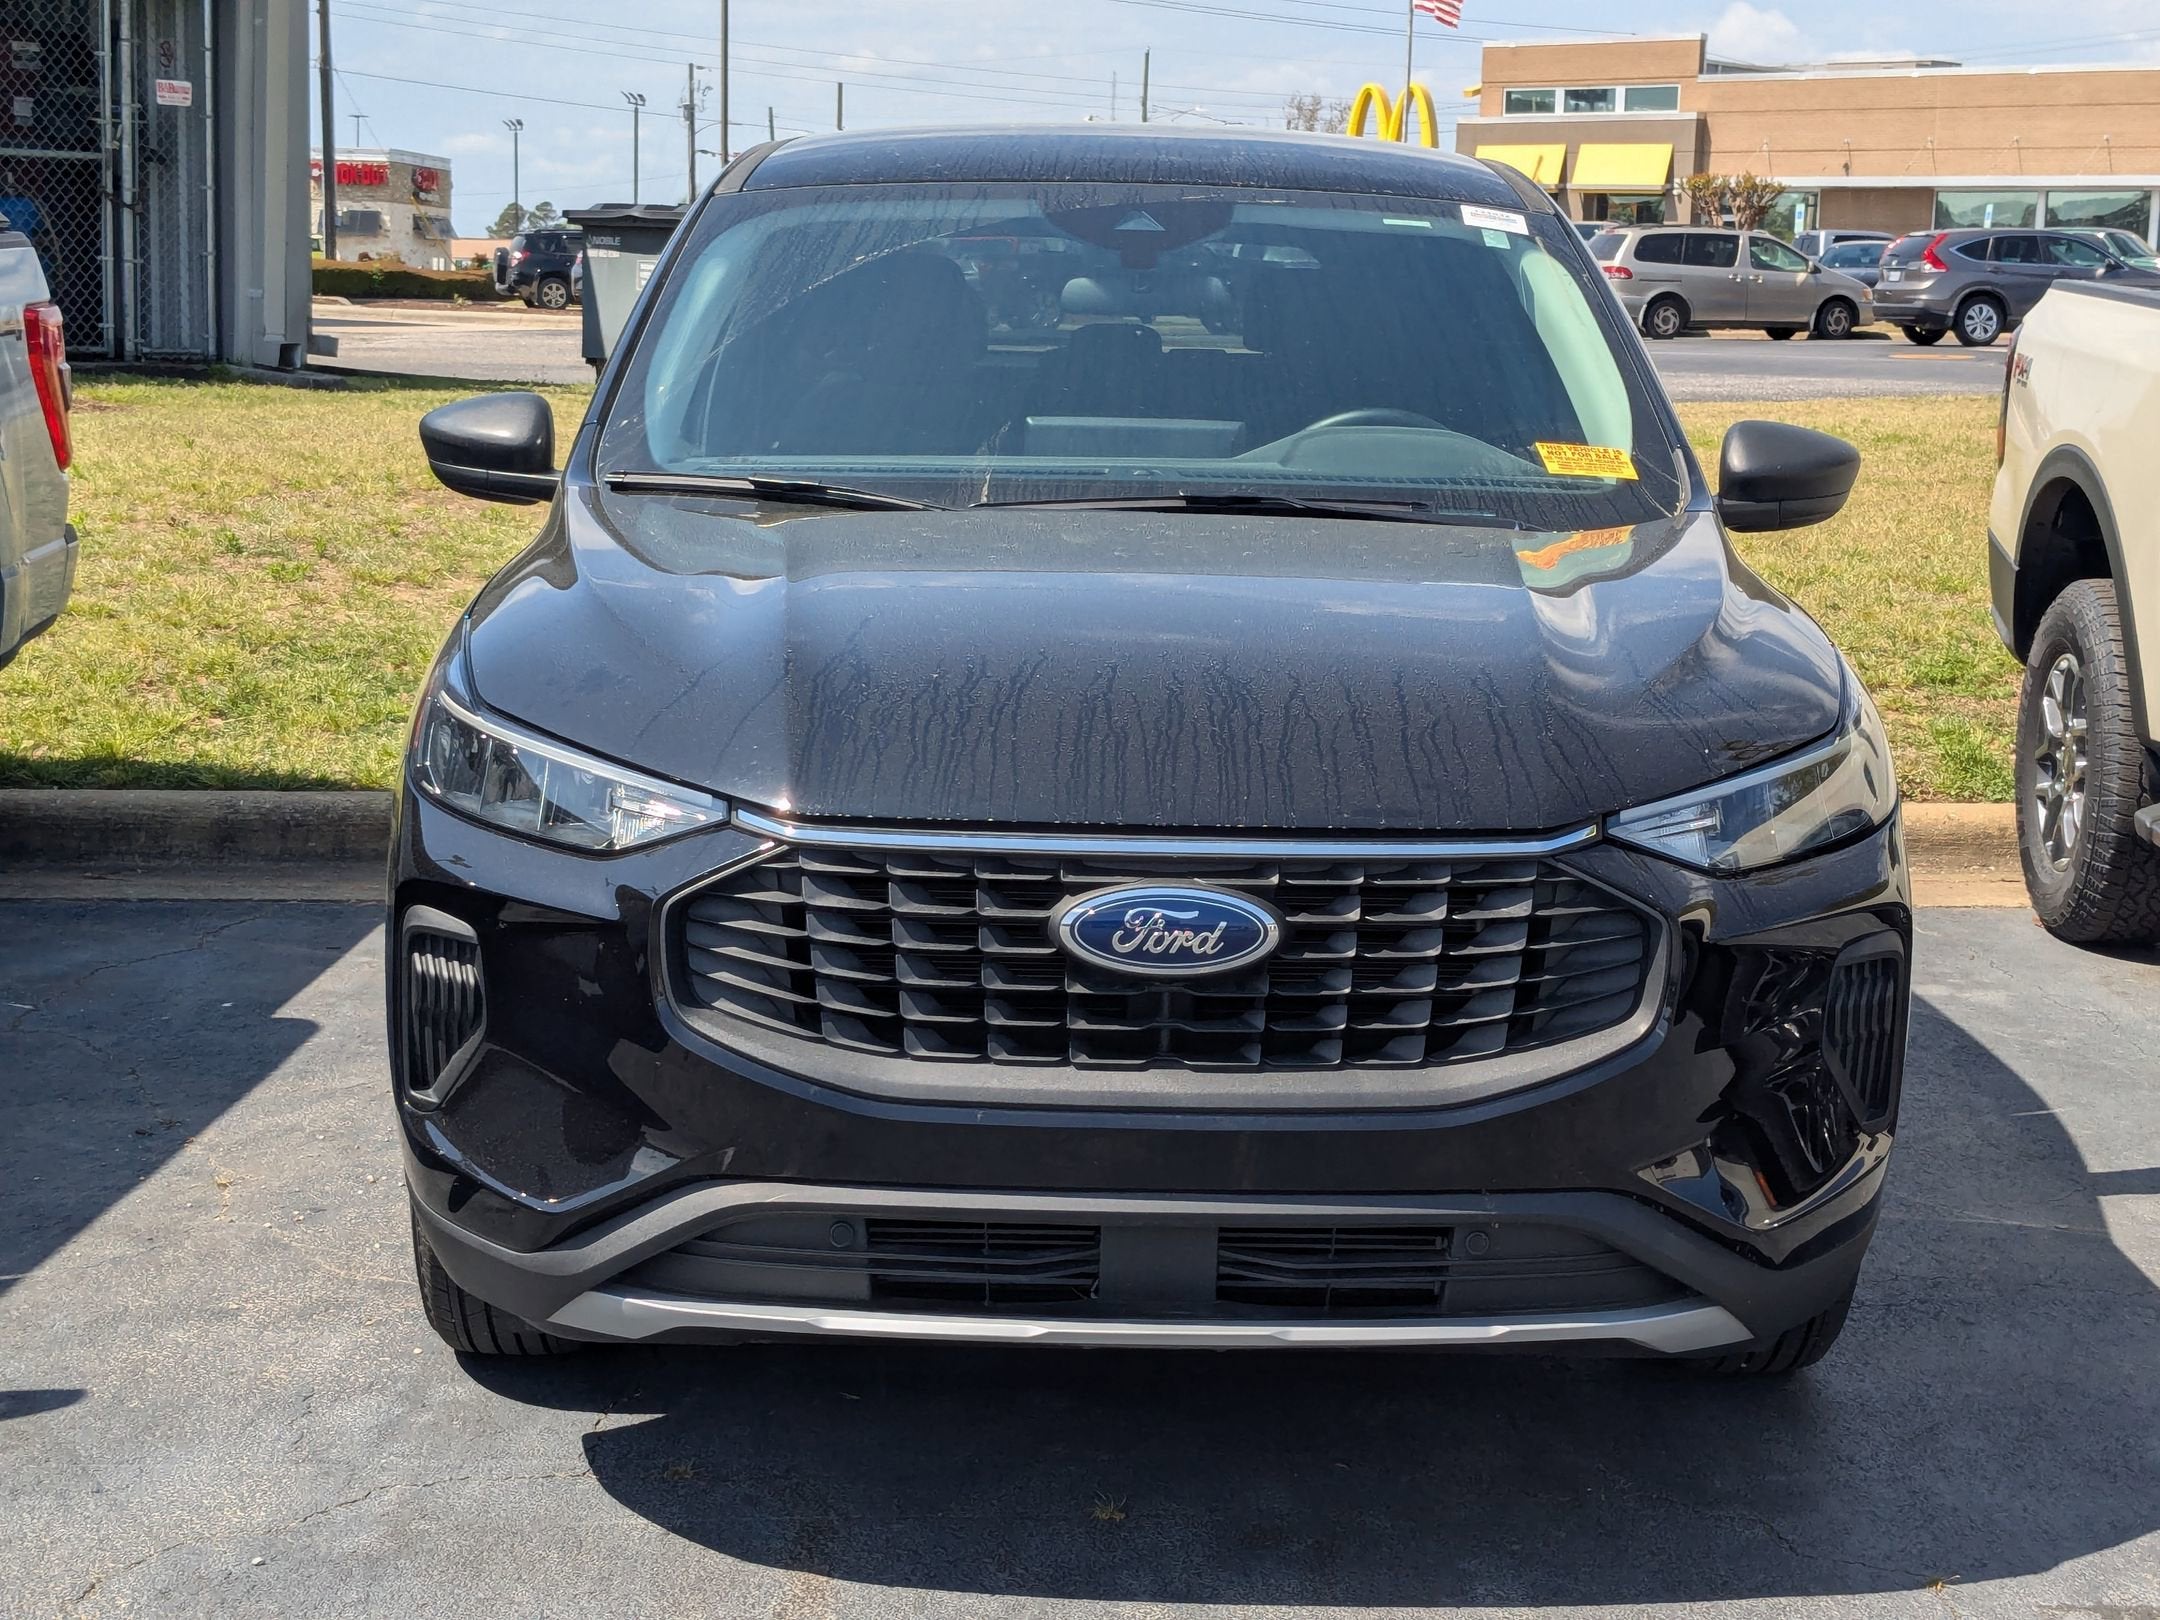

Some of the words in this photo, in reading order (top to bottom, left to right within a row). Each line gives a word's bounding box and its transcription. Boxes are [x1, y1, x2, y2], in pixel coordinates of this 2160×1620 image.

[1540, 444, 1564, 452] THIS
[1566, 445, 1609, 454] VEHICLE
[1571, 451, 1593, 459] FOR
[1112, 907, 1227, 954] Ford
